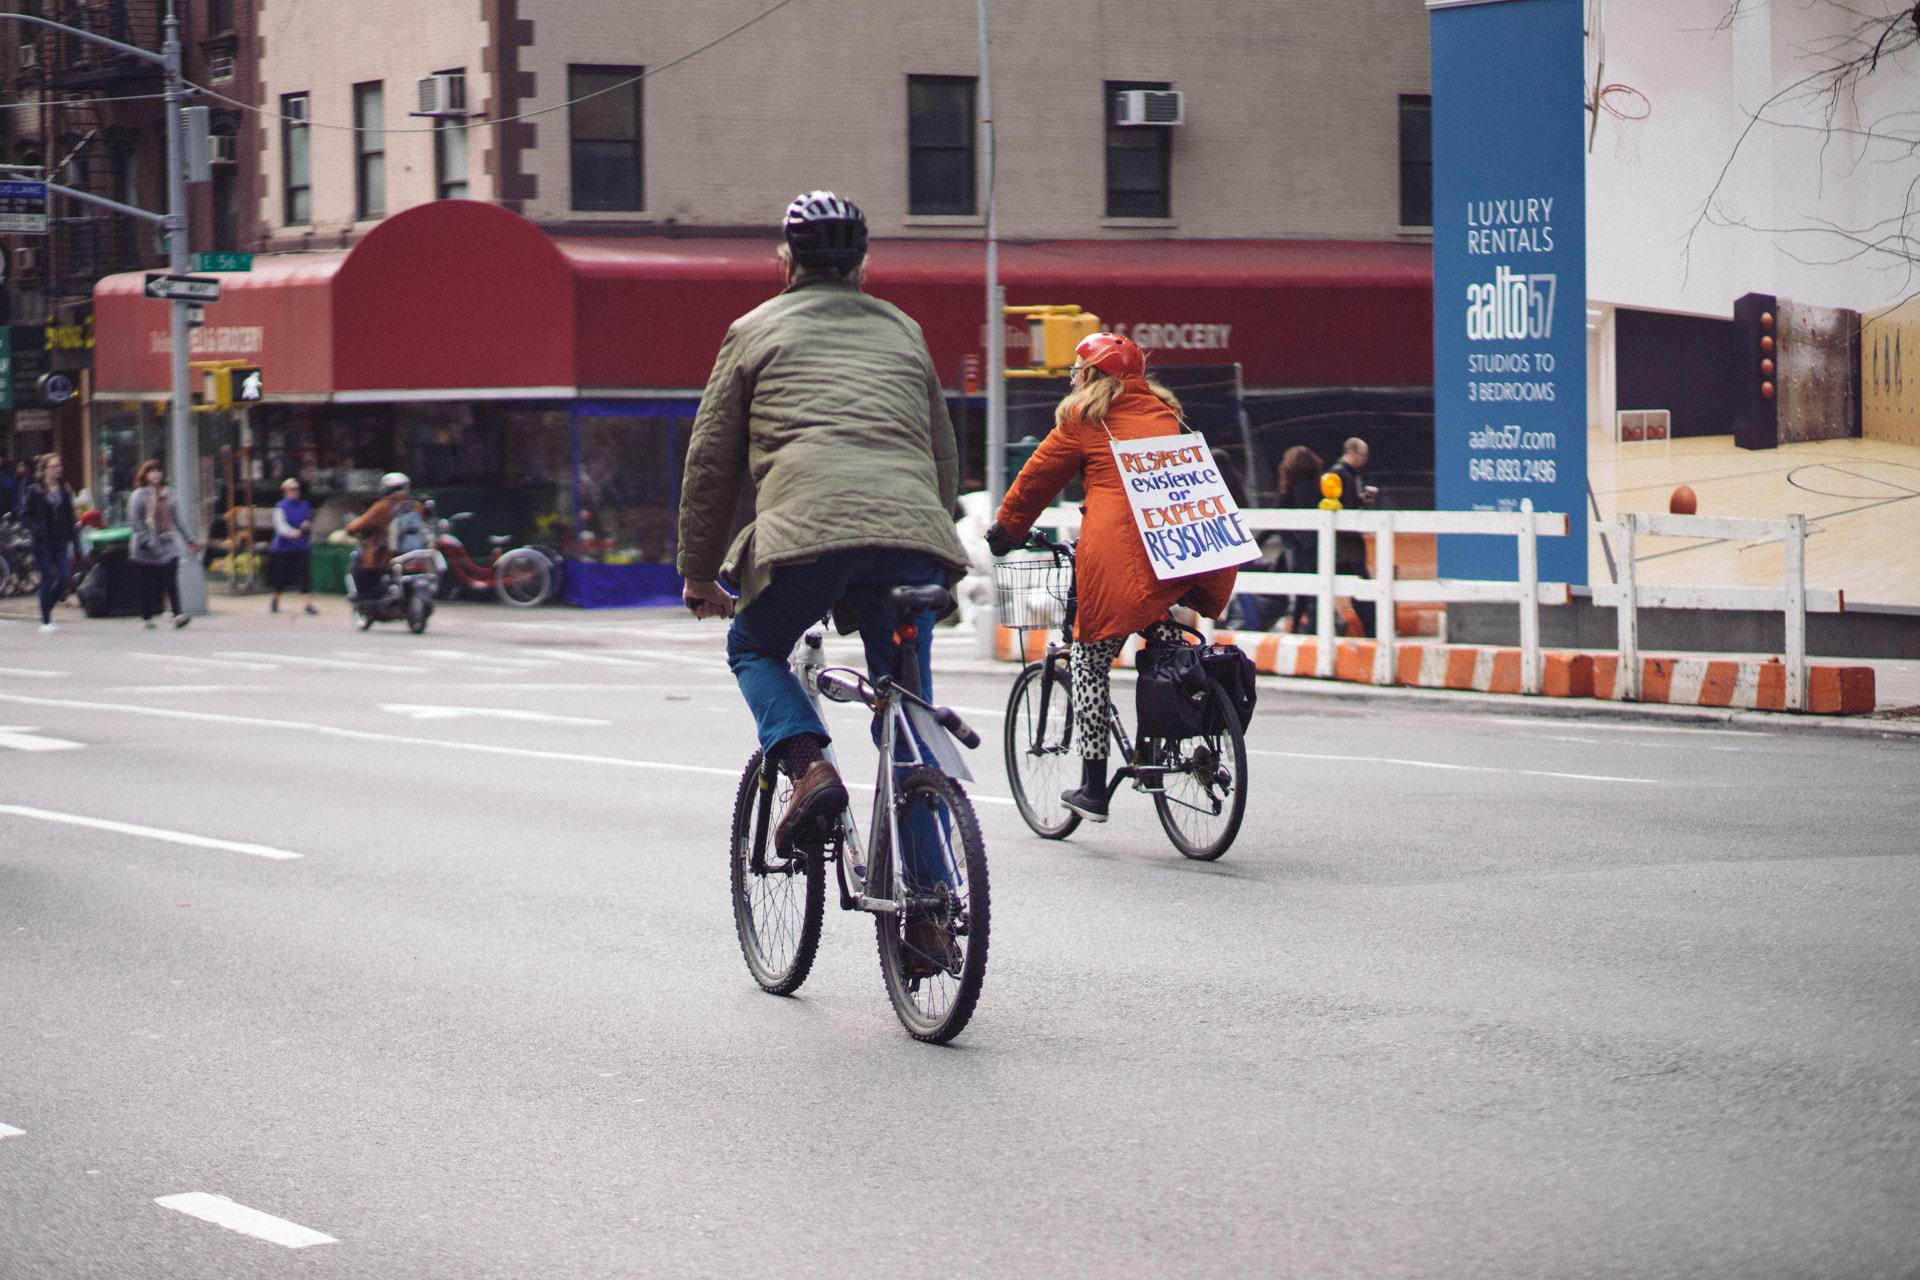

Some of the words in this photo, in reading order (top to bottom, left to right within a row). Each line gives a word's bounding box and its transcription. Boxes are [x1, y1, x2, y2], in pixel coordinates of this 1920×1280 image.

[1467, 197, 1553, 227] LUXURY
[1468, 226, 1554, 255] RENTALS
[204, 255, 211, 270] E
[156, 280, 174, 291] ONE
[1466, 265, 1557, 341] aalto57
[1132, 323, 1232, 350] GROCERY
[1468, 353, 1531, 373] STUDIOS
[1533, 353, 1555, 373] TO
[1468, 381, 1477, 401] 3
[1478, 381, 1555, 401] BEDROOMS
[1468, 424, 1556, 450] aalto57.com
[1117, 445, 1204, 474] RESPECT
[1469, 458, 1557, 483] 646.893.2496
[1131, 468, 1218, 493] existence
[1168, 489, 1191, 501] or
[1141, 494, 1227, 529] EXPECT
[1144, 511, 1254, 570] RESISTANCE
